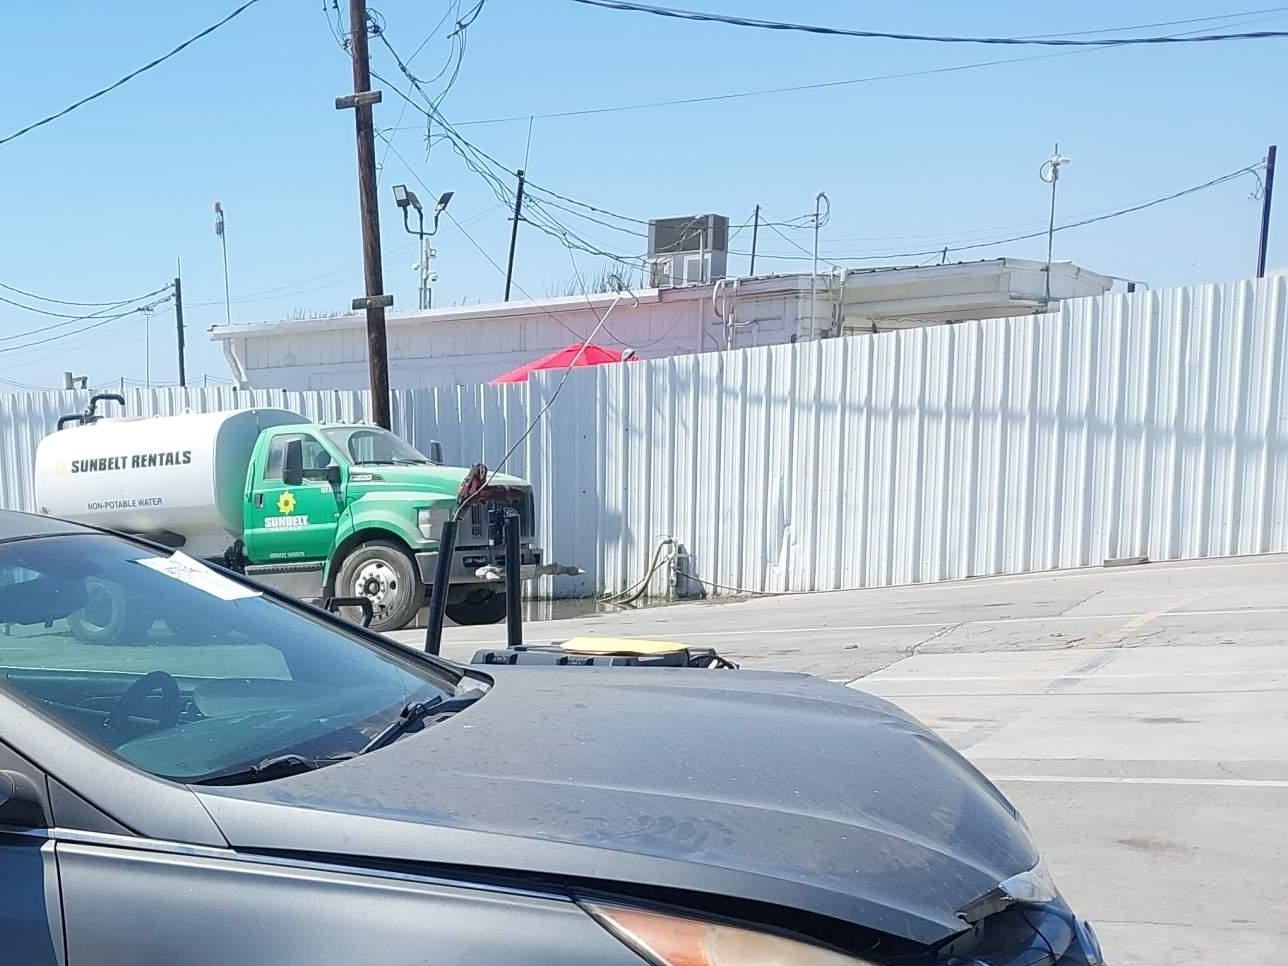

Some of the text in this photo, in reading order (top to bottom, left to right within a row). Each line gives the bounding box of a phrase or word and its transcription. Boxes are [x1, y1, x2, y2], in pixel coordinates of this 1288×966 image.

[71, 450, 192, 473] SUNBELT RENTALS
[87, 497, 163, 510] NON-POTABLE WATER
